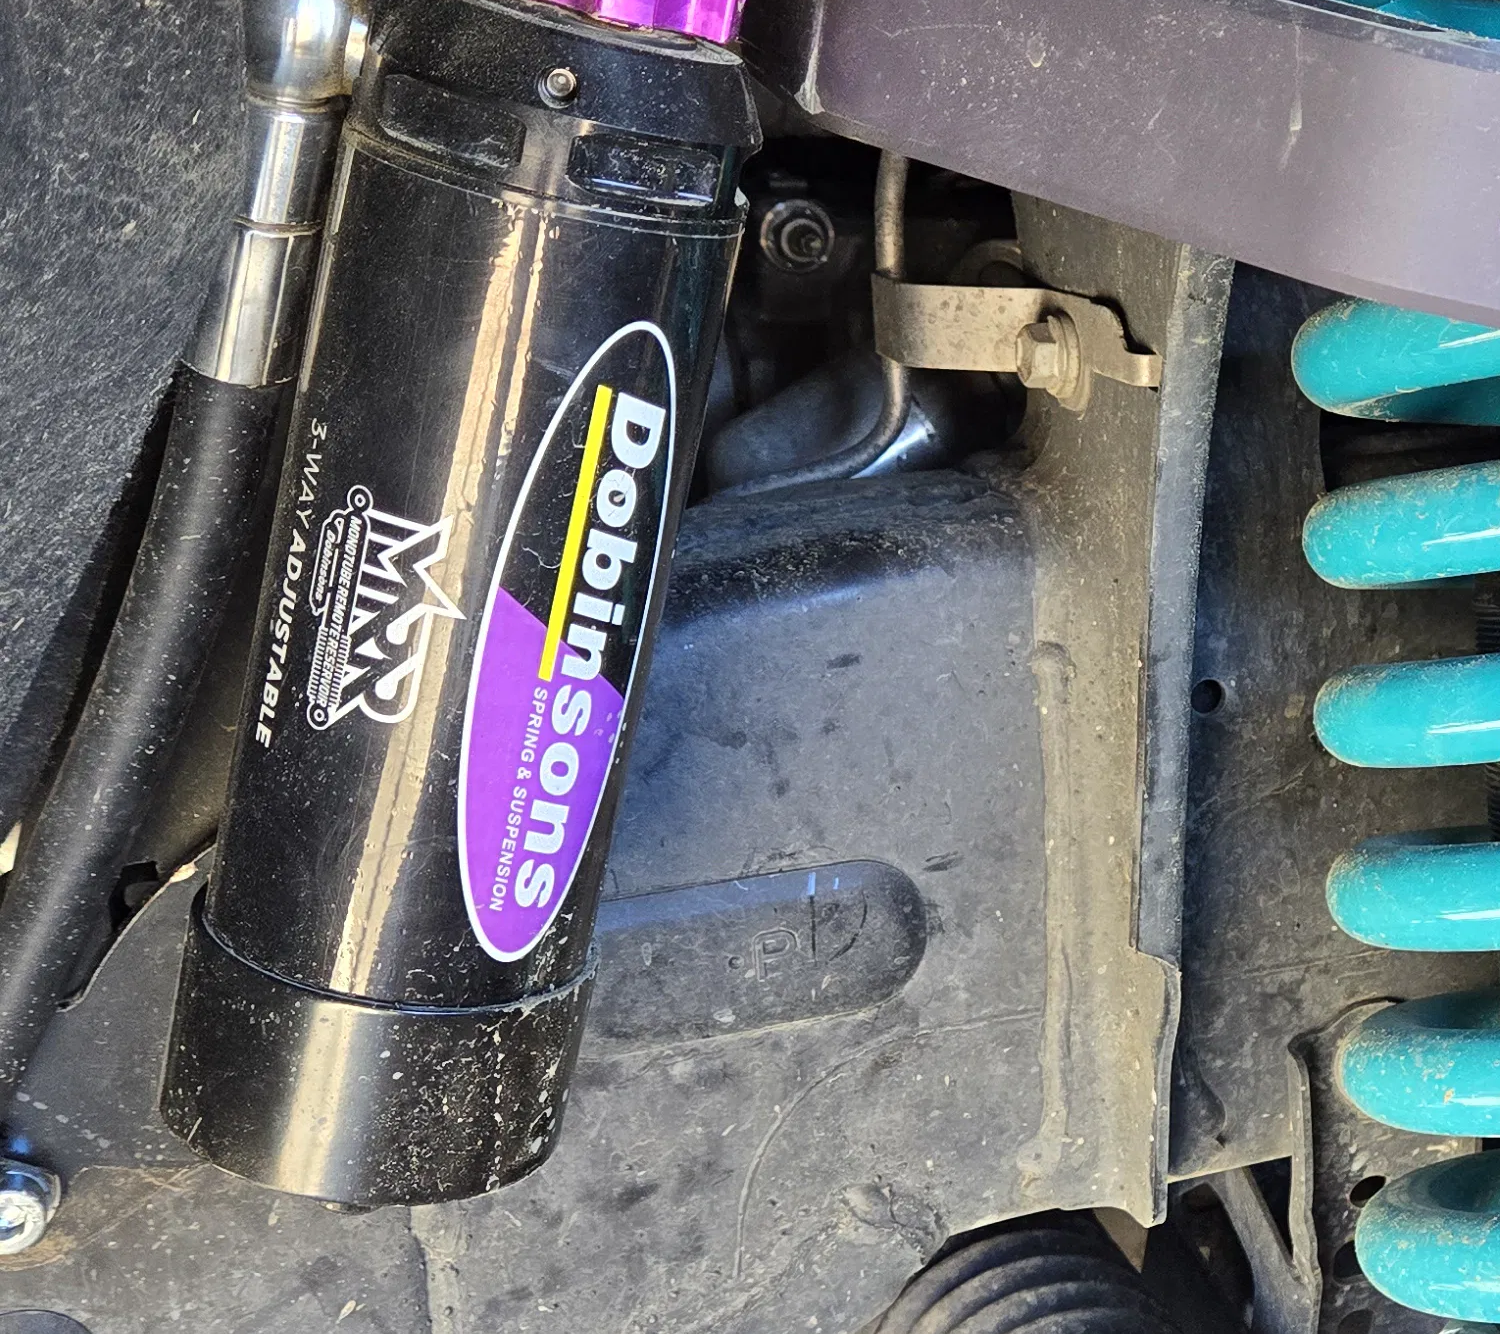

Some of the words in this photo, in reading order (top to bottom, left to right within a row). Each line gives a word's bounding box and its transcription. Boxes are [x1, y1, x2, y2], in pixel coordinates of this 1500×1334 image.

[296, 418, 327, 529] 3-WAY
[314, 528, 336, 603] Dobinsons
[338, 515, 363, 588] MONOTUBE
[256, 529, 307, 748] ADJUSTABLE
[328, 587, 349, 640] REMOTE
[514, 390, 667, 909] Dobinsons
[316, 637, 340, 708] RESERVOIR
[520, 686, 548, 764] SPRING
[516, 766, 532, 780] &
[489, 785, 528, 912] SUSPENSION
